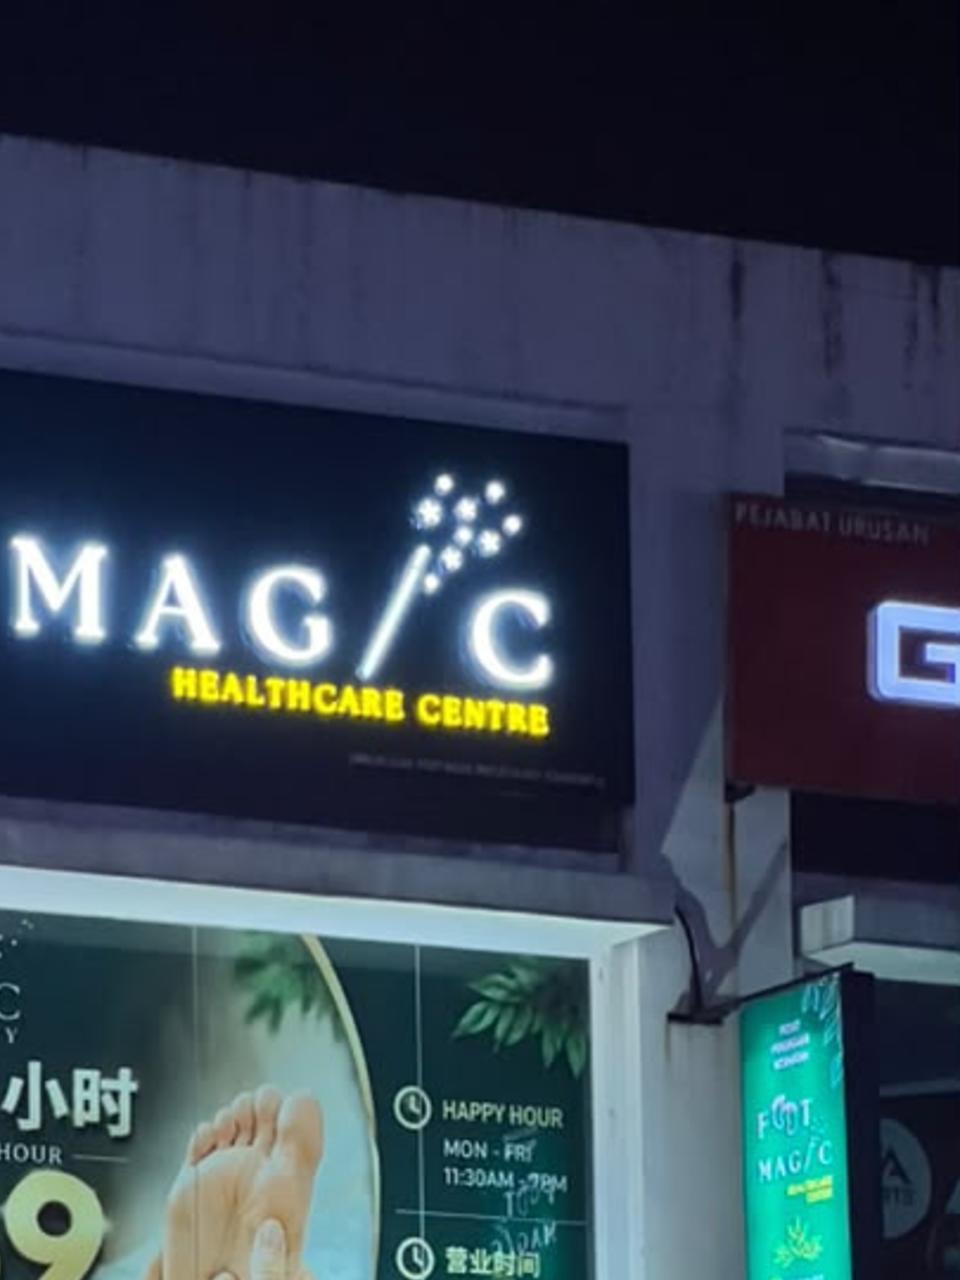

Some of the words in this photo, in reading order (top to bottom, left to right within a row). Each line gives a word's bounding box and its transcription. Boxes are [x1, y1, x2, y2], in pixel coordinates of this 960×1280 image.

[736, 502, 831, 533] PEJABAT
[839, 515, 930, 546] URUSAN
[170, 666, 406, 721] HEALTHCARE
[417, 693, 551, 737] CENTRE
[442, 1099, 506, 1125] HAPPY
[508, 1105, 565, 1129] HOUR
[443, 1139, 488, 1159] MON
[503, 1142, 535, 1163] FRI
[443, 1167, 516, 1188] 11:30AM
[445, 1246, 541, 1279] 营业时间
